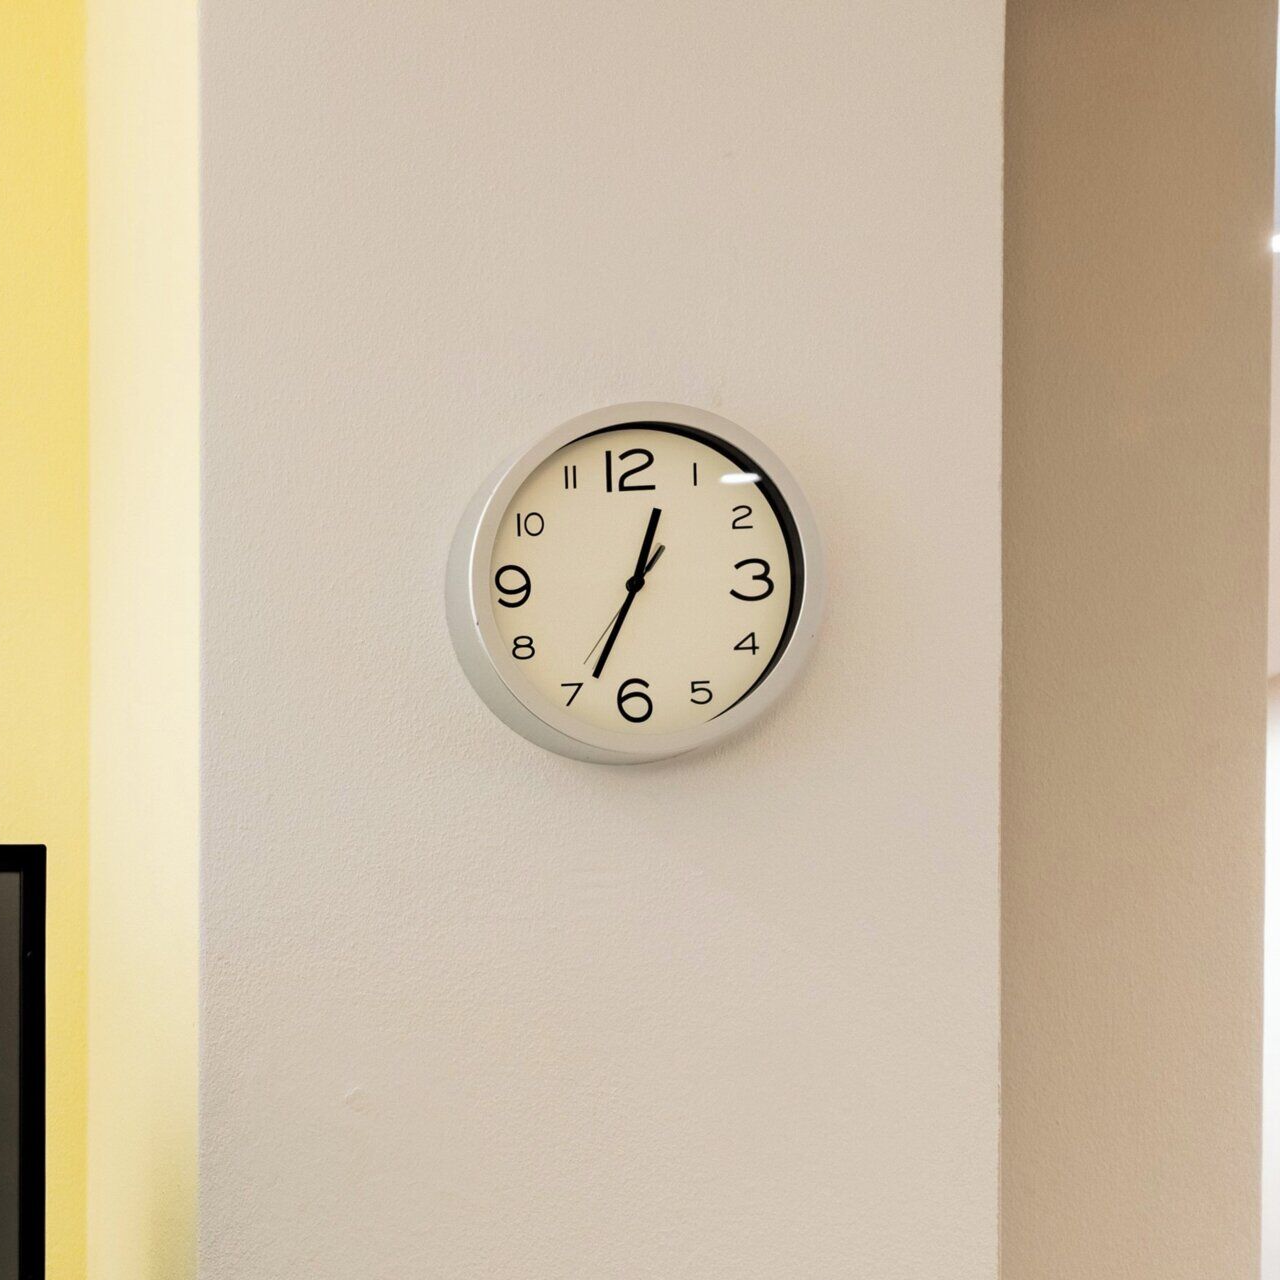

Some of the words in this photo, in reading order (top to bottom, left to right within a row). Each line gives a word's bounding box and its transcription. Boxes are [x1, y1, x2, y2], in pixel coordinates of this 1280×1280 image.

[564, 465, 577, 489] 11
[605, 448, 656, 493] 12
[692, 462, 698, 487] 1
[516, 512, 545, 537] 10
[731, 504, 754, 530] 2
[494, 564, 532, 608] 9
[729, 558, 775, 602] 3
[511, 635, 536, 660] 8
[733, 631, 760, 656] 4
[560, 682, 584, 707] 7
[616, 677, 654, 723] 6
[690, 680, 713, 705] 5
